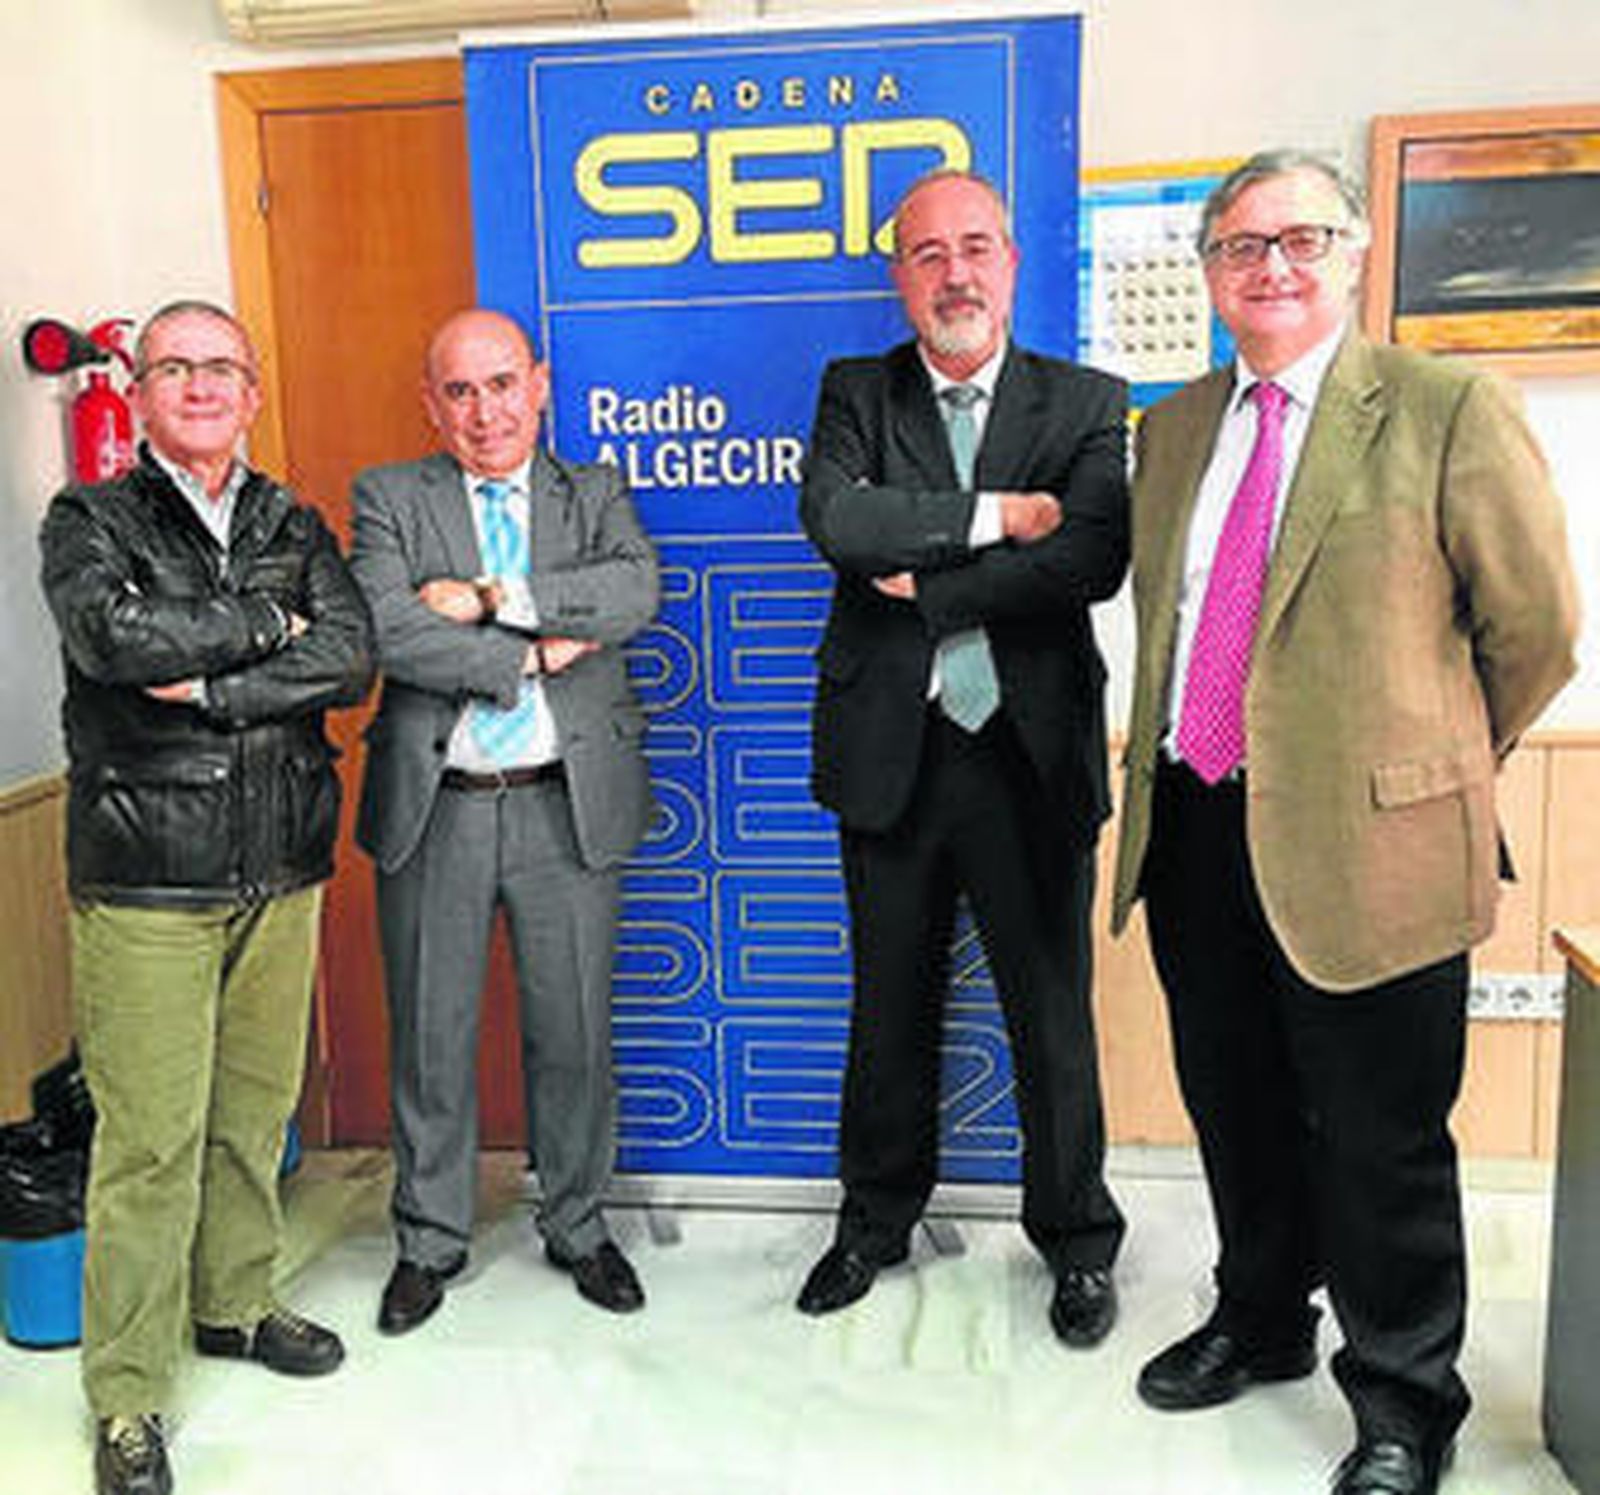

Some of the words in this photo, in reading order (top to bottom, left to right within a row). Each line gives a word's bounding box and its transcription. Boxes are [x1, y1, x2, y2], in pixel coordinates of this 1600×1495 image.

[646, 73, 899, 116] CADENA
[575, 118, 972, 268] SER
[590, 383, 726, 436] Radio
